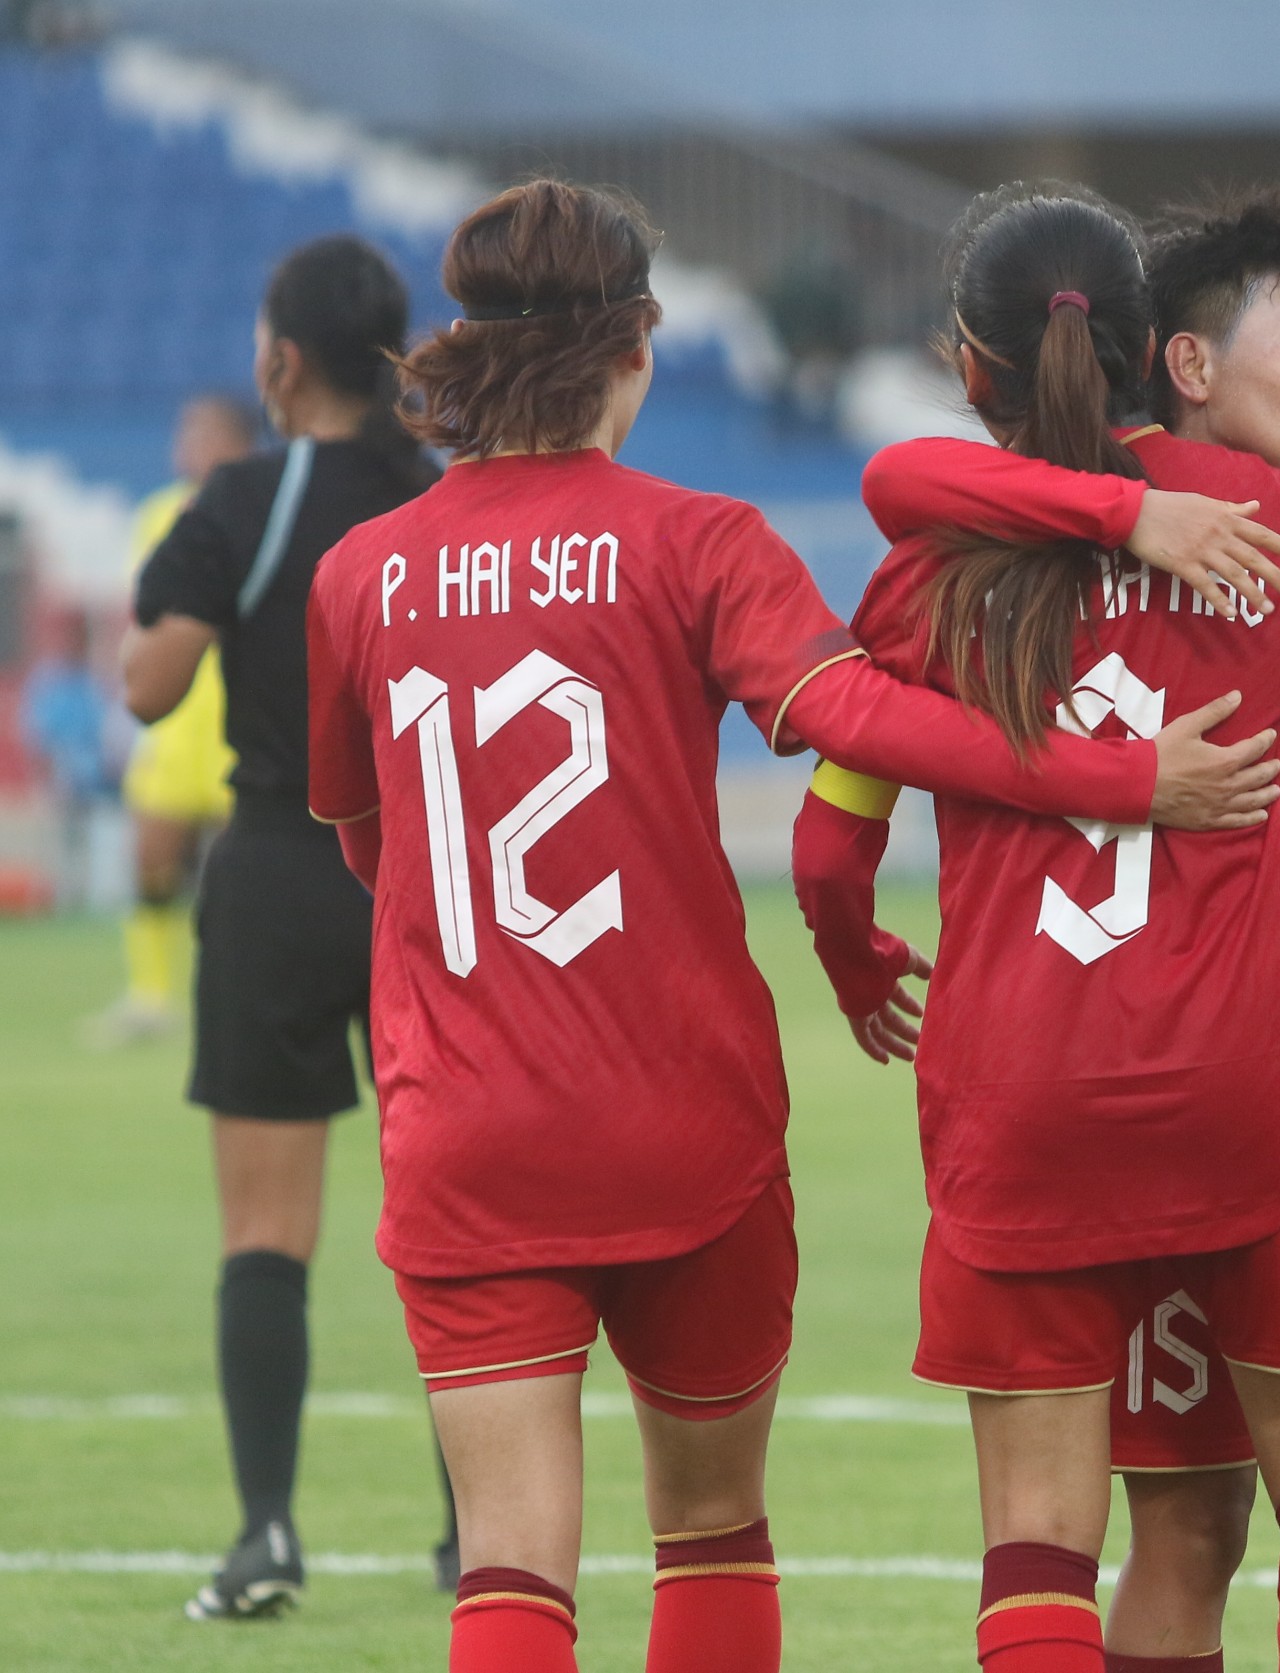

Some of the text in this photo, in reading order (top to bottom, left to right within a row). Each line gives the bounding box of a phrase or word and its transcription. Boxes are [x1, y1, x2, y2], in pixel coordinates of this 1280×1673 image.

[381, 531, 620, 628] P. HAI YEN
[386, 647, 625, 979] 12
[1034, 651, 1166, 966] 9
[1126, 1287, 1209, 1416] 15
